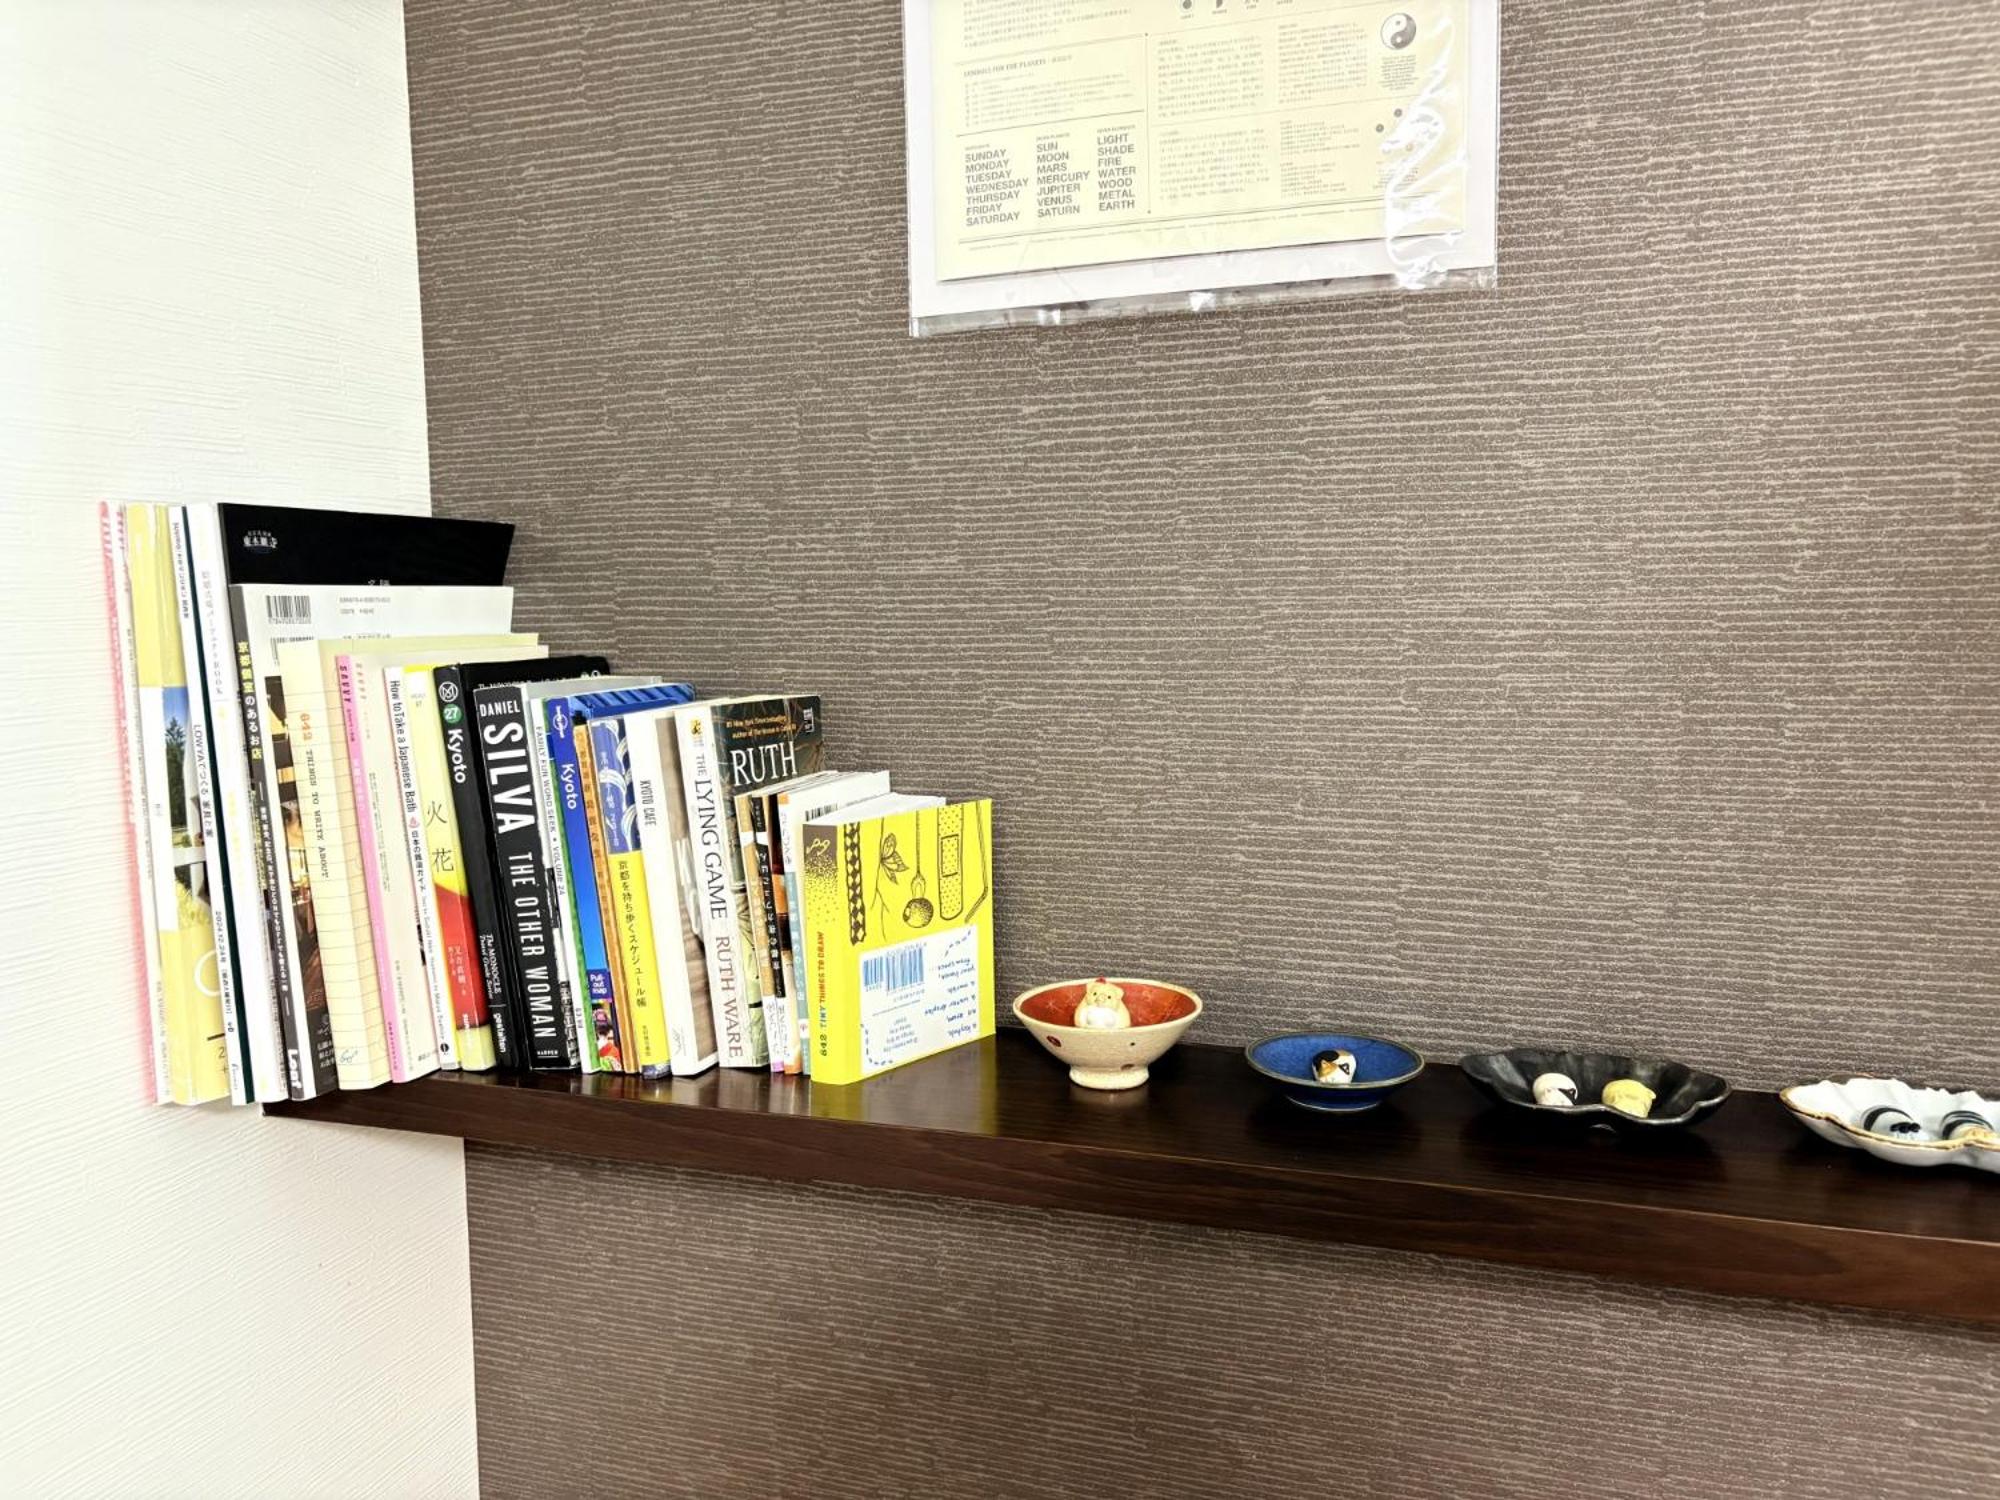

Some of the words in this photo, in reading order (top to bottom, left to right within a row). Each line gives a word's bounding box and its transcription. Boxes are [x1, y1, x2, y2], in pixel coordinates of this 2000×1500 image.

[1036, 142, 1059, 153] SUN
[1097, 133, 1129, 145] LIGHT
[965, 149, 1006, 163] SUNDAY
[1037, 152, 1070, 164] MOON
[1097, 144, 1135, 157] SHADE
[965, 159, 1010, 173] MONDAY
[1037, 162, 1067, 174] MARS
[1098, 156, 1122, 167] FIRE
[966, 169, 1012, 184] TUESDAY
[1037, 170, 1090, 185] MERCURY
[1098, 166, 1136, 178] WATER
[966, 178, 1029, 195] WEDNESDAY
[1037, 183, 1081, 196] JUPITER
[1098, 178, 1133, 189] WOOD
[966, 190, 1020, 205] THURSDAY
[1037, 194, 1072, 207] VENUS
[1099, 189, 1135, 201] METAL
[966, 203, 1002, 216] FRIDAY
[1038, 205, 1080, 218] SATURN
[1099, 200, 1135, 212] EARTH
[966, 212, 1020, 227] SATURDAY
[340, 666, 352, 702] SAVVY
[390, 680, 400, 700] How
[443, 707, 458, 721] 27
[479, 700, 521, 717] DANIEL
[395, 711, 405, 735] Take
[447, 729, 467, 784] Kyoto
[696, 755, 708, 777] THE
[730, 741, 798, 787] RUTH
[306, 750, 317, 787] THINGS
[398, 745, 412, 789] Japanese
[540, 760, 548, 778] FUN
[483, 722, 535, 834] SILVA
[561, 764, 577, 810] Kyoto
[313, 791, 320, 805] TO
[405, 791, 416, 813] Bath
[639, 780, 652, 805] KYOTO
[644, 806, 657, 827] CAFE
[694, 780, 720, 846] LYING
[315, 810, 325, 841] WRITE
[319, 846, 329, 879] ABOUT
[508, 852, 537, 887] THE
[704, 852, 729, 920] GAME
[514, 896, 545, 957] OTHER
[619, 860, 648, 1008] 京都を持ち歩くスケジュール帳
[485, 934, 495, 948] The
[817, 931, 825, 958] DRAW
[488, 949, 503, 994] MONOCLE
[716, 936, 736, 991] RUTH
[817, 960, 825, 971] TO
[817, 973, 826, 1003] THINGS
[525, 966, 557, 1038] WOMAN
[819, 1005, 827, 1029] TINY
[492, 1012, 507, 1053] gestalten
[723, 998, 743, 1058] WARE
